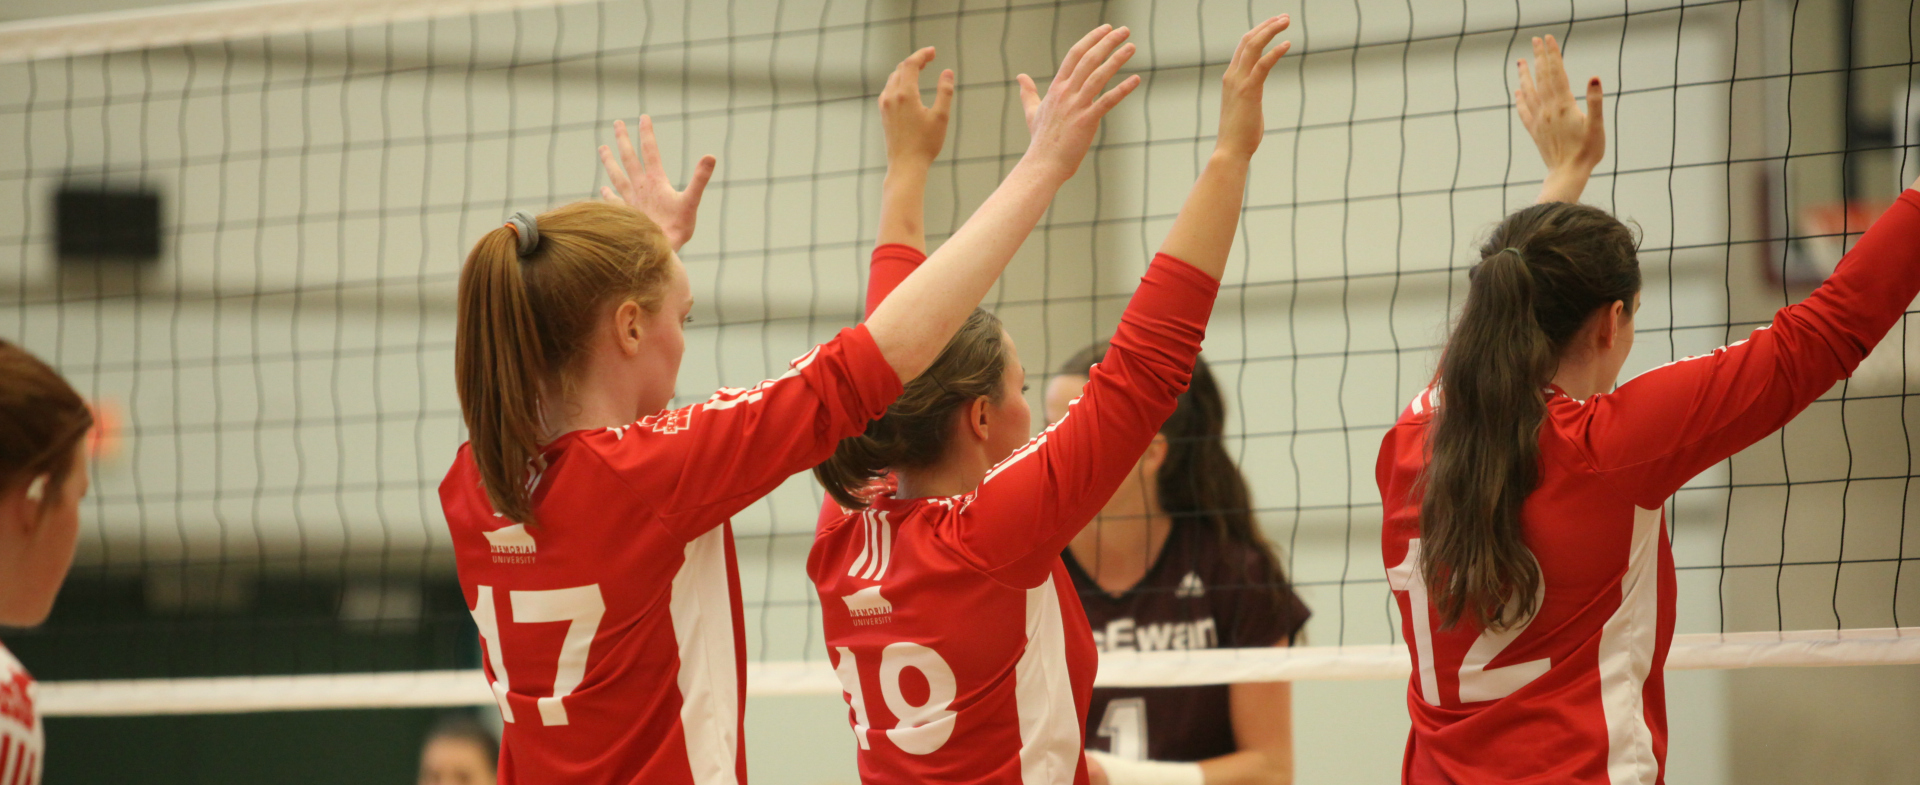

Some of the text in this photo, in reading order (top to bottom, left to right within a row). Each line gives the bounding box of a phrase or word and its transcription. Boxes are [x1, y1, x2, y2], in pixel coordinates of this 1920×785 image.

[490, 545, 536, 554] MEMORIAL
[492, 555, 536, 564] UNIVERSITY
[850, 605, 892, 617] MEMORIAL
[853, 616, 892, 626] UNIVERSITY
[1386, 537, 1552, 706] 12
[470, 583, 606, 726] 17
[835, 642, 957, 755] 18
